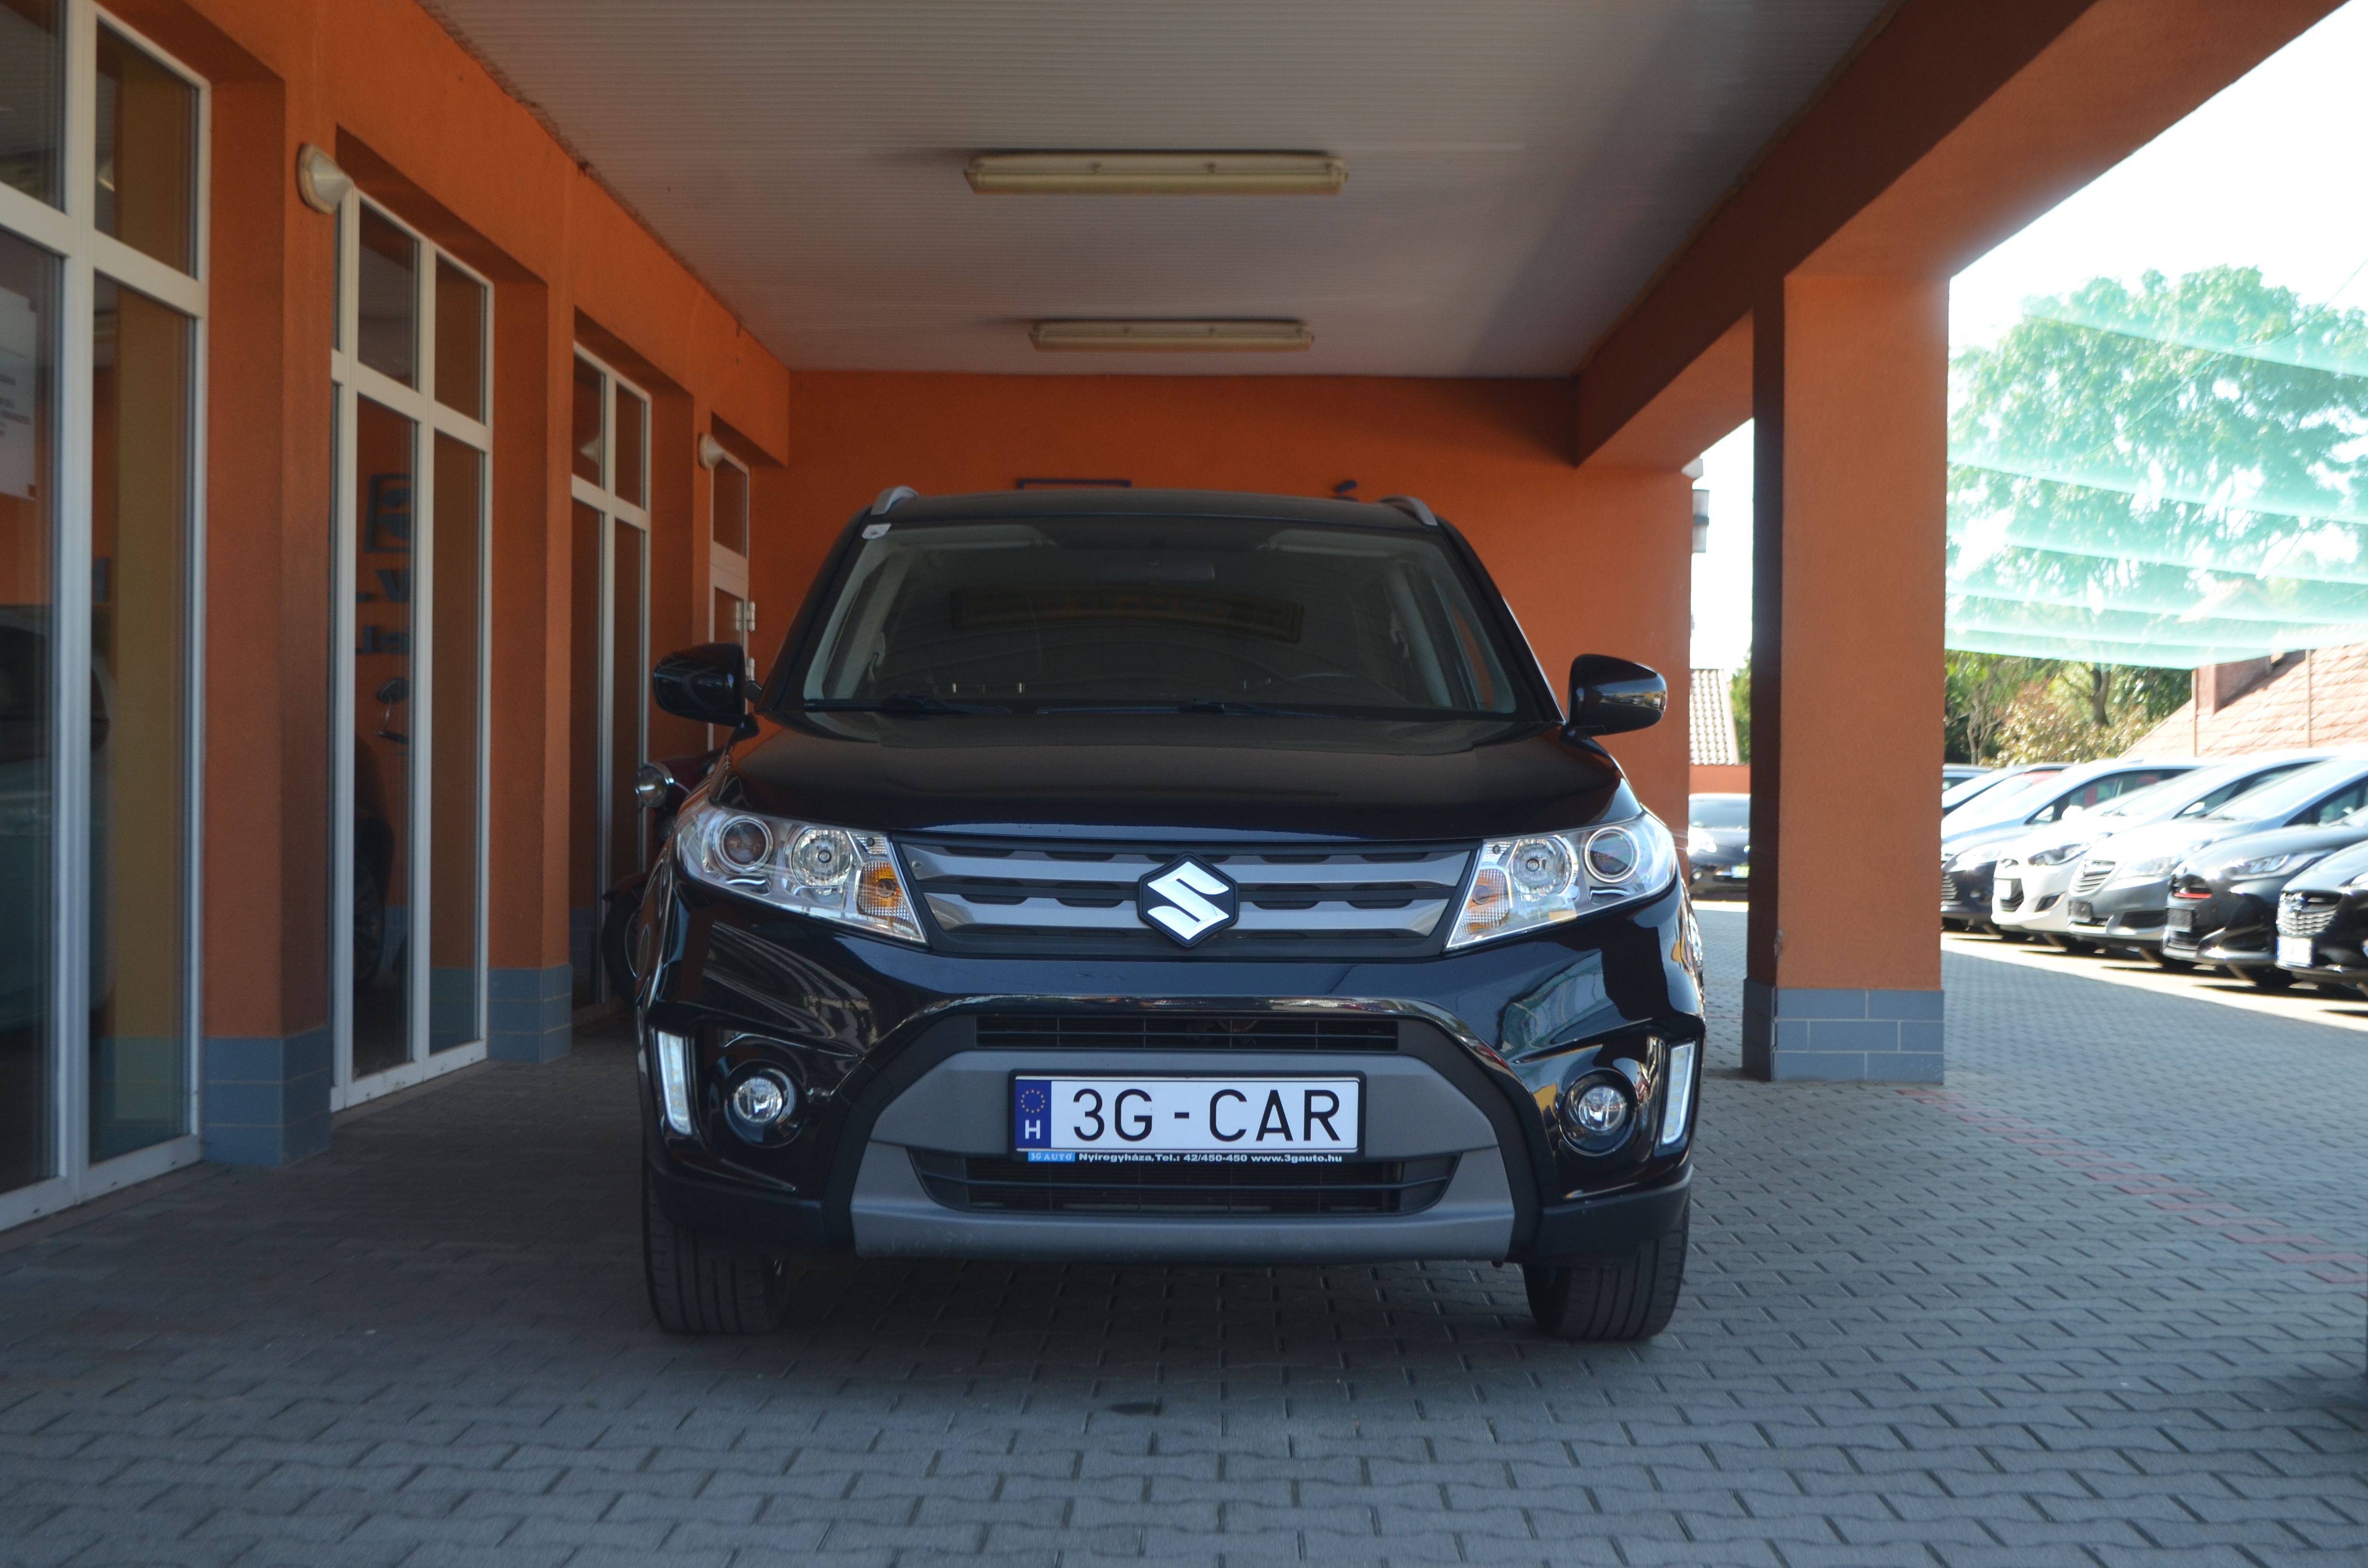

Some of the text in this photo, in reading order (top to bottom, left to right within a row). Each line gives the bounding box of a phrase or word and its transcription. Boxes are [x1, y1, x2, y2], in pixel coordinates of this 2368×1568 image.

[1024, 1119, 1041, 1139] H
[1183, 1154, 1247, 1162] 42/450-450
[1250, 1154, 1342, 1164] www.3gauto.hu
